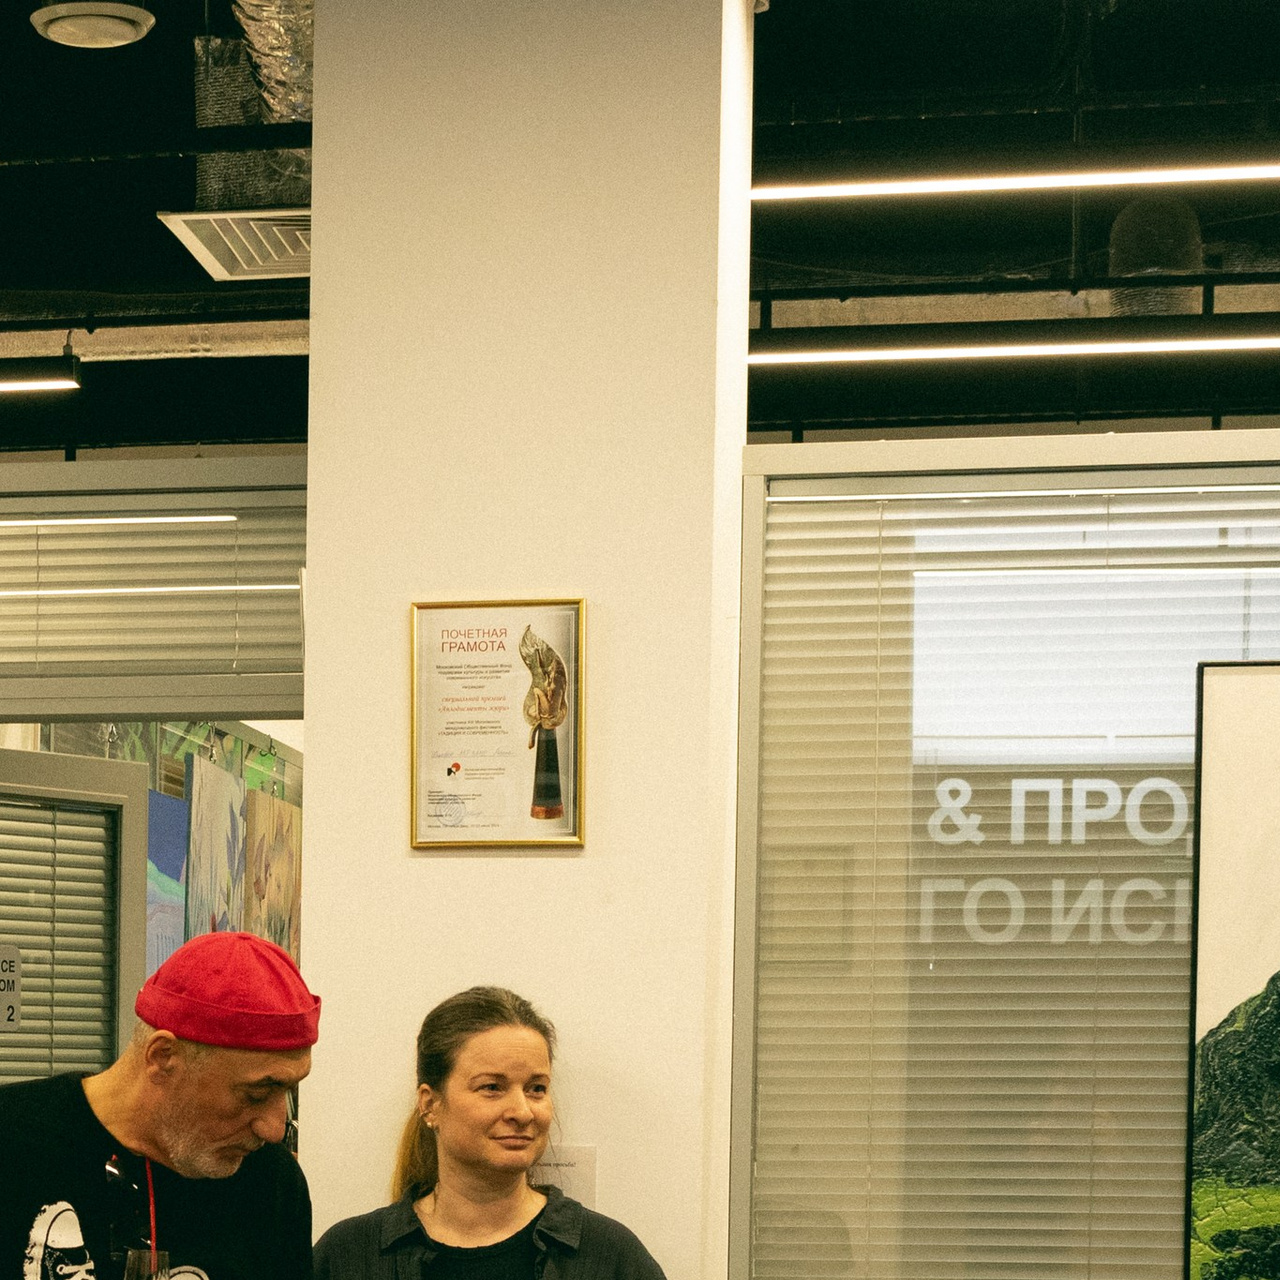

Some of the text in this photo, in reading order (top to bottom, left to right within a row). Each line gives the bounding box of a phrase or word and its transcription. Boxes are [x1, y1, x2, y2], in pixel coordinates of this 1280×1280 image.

[441, 627, 508, 640] ПОЧЕТНАЯ
[441, 640, 506, 653] ГРАМОТА
[926, 776, 1193, 857] & ПРО
[919, 877, 1026, 945] ГО
[6, 1004, 16, 1022] 2
